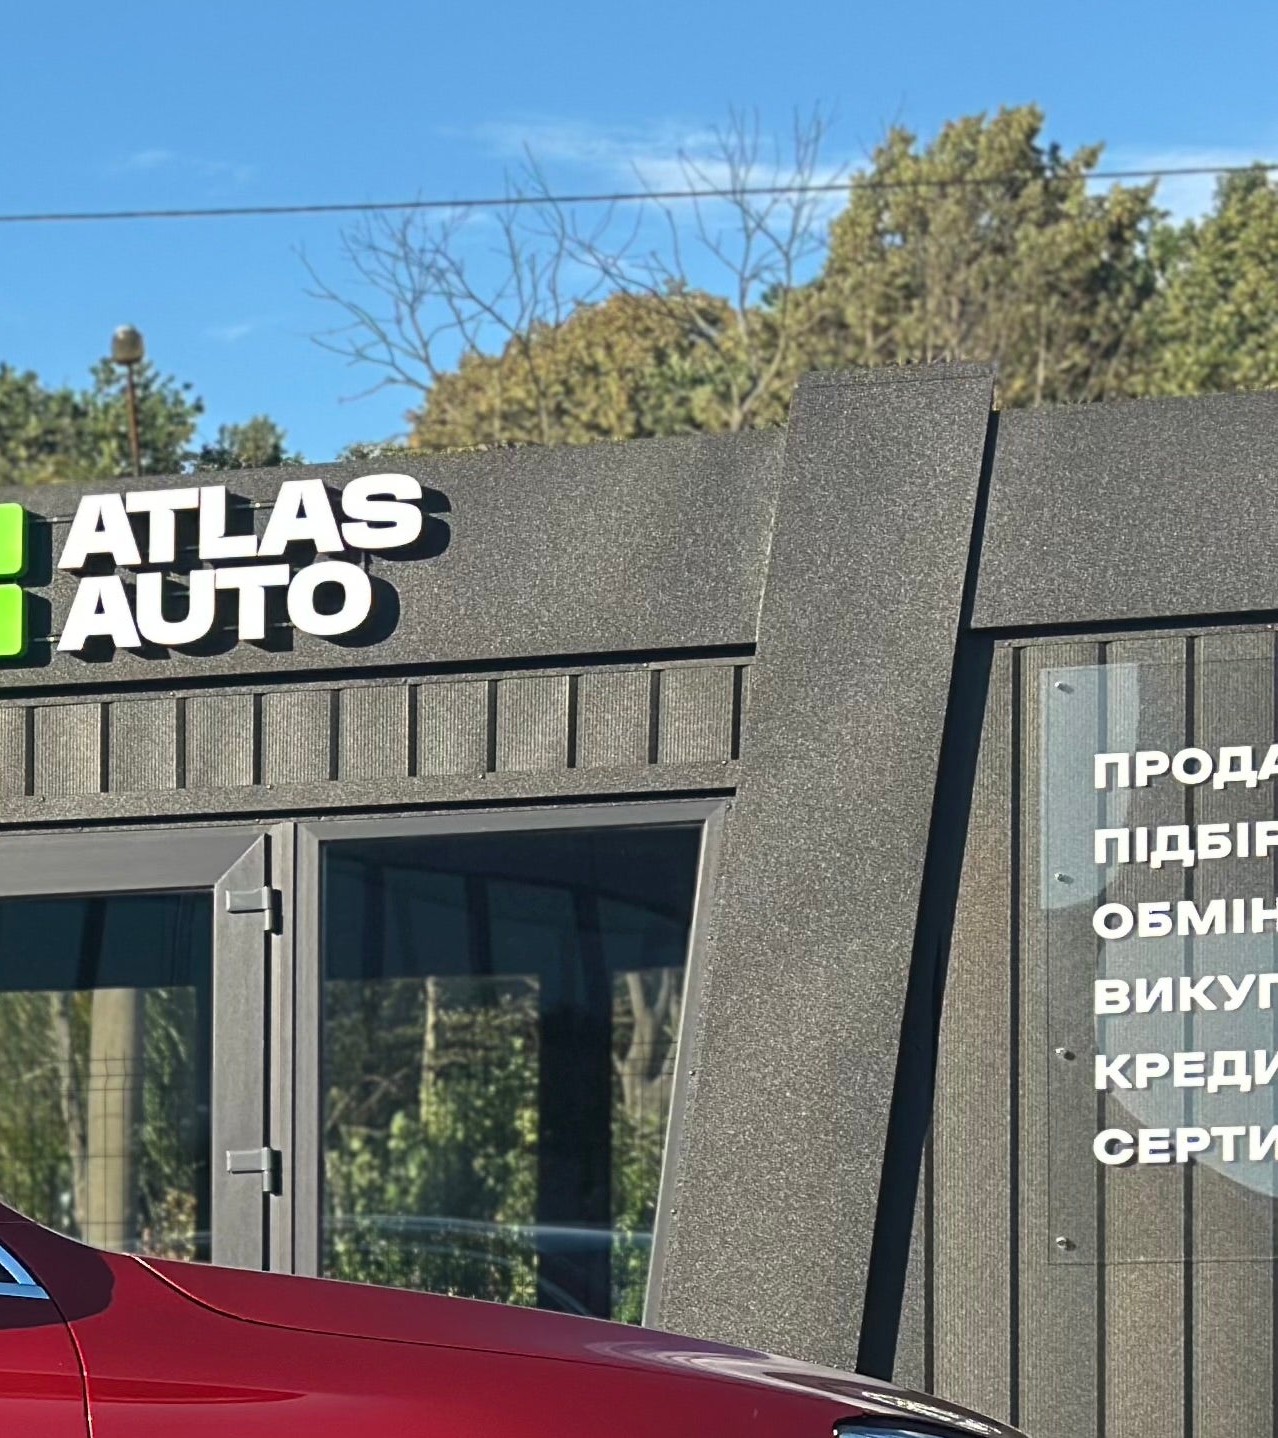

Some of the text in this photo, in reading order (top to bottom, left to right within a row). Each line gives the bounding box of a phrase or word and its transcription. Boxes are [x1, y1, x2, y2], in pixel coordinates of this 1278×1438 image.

[57, 473, 422, 569] ATLAS
[56, 560, 372, 652] AUTO
[1094, 820, 1278, 869] ПІДБІР
[1092, 897, 1278, 940] ОБМІН
[1093, 1125, 1278, 1165] СЕРТИ
